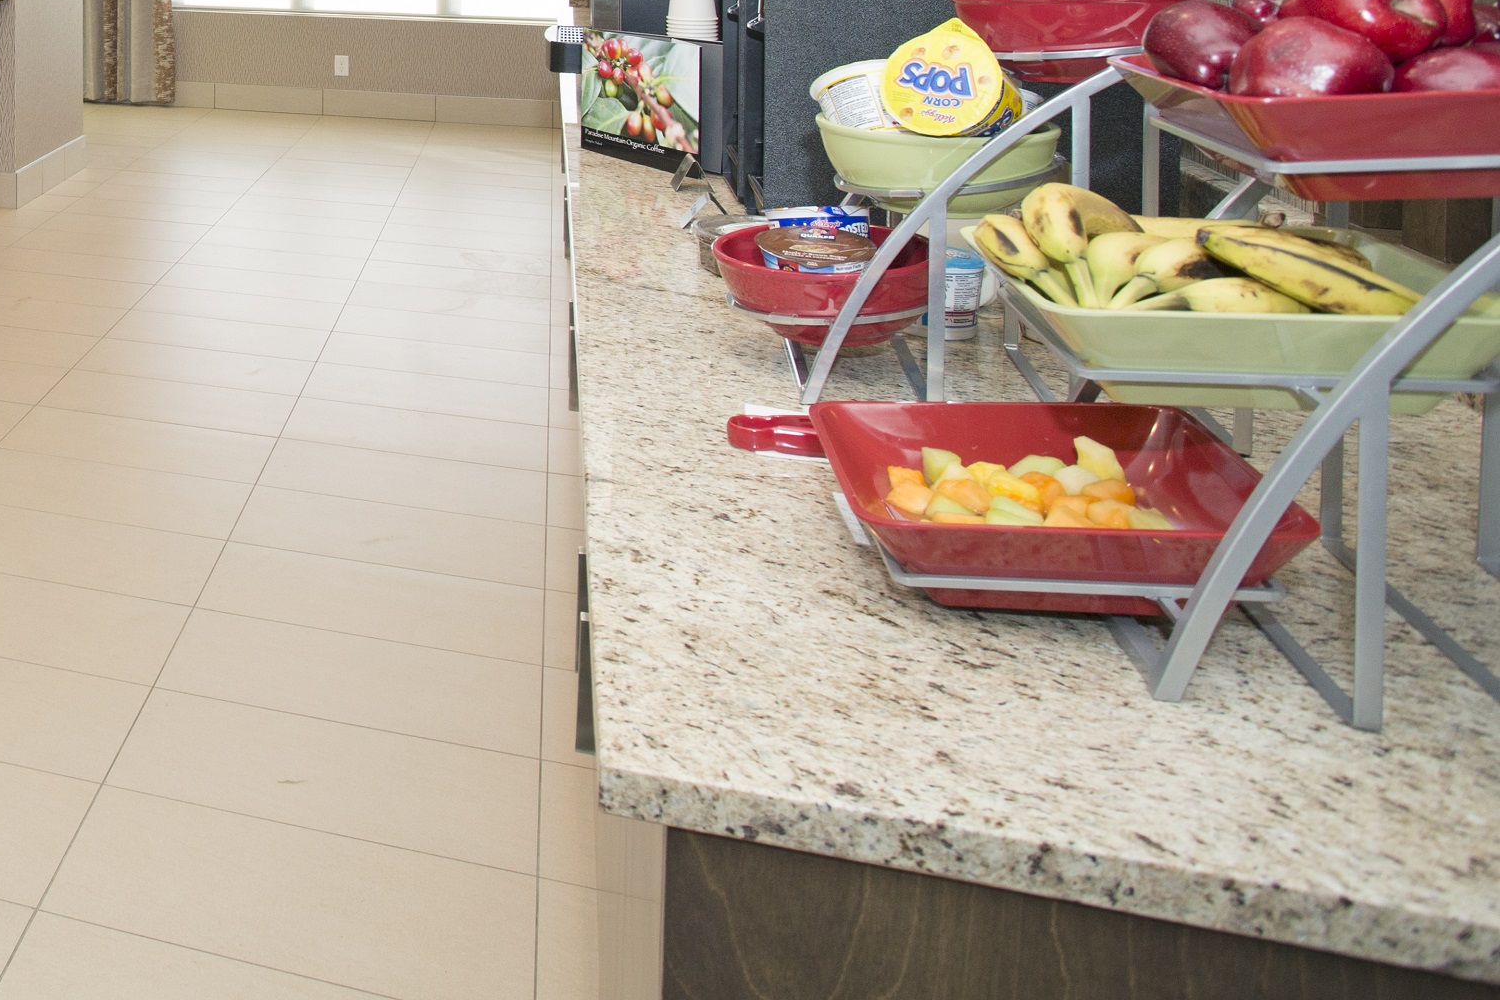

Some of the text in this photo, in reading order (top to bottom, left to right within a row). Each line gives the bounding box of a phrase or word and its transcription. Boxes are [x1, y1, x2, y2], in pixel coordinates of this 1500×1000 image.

[899, 62, 973, 97] POPS
[922, 95, 961, 107] CORN
[584, 128, 604, 139] Paradise
[603, 133, 626, 145] Mountain
[626, 139, 646, 149] Organic
[646, 143, 665, 155] Coffee
